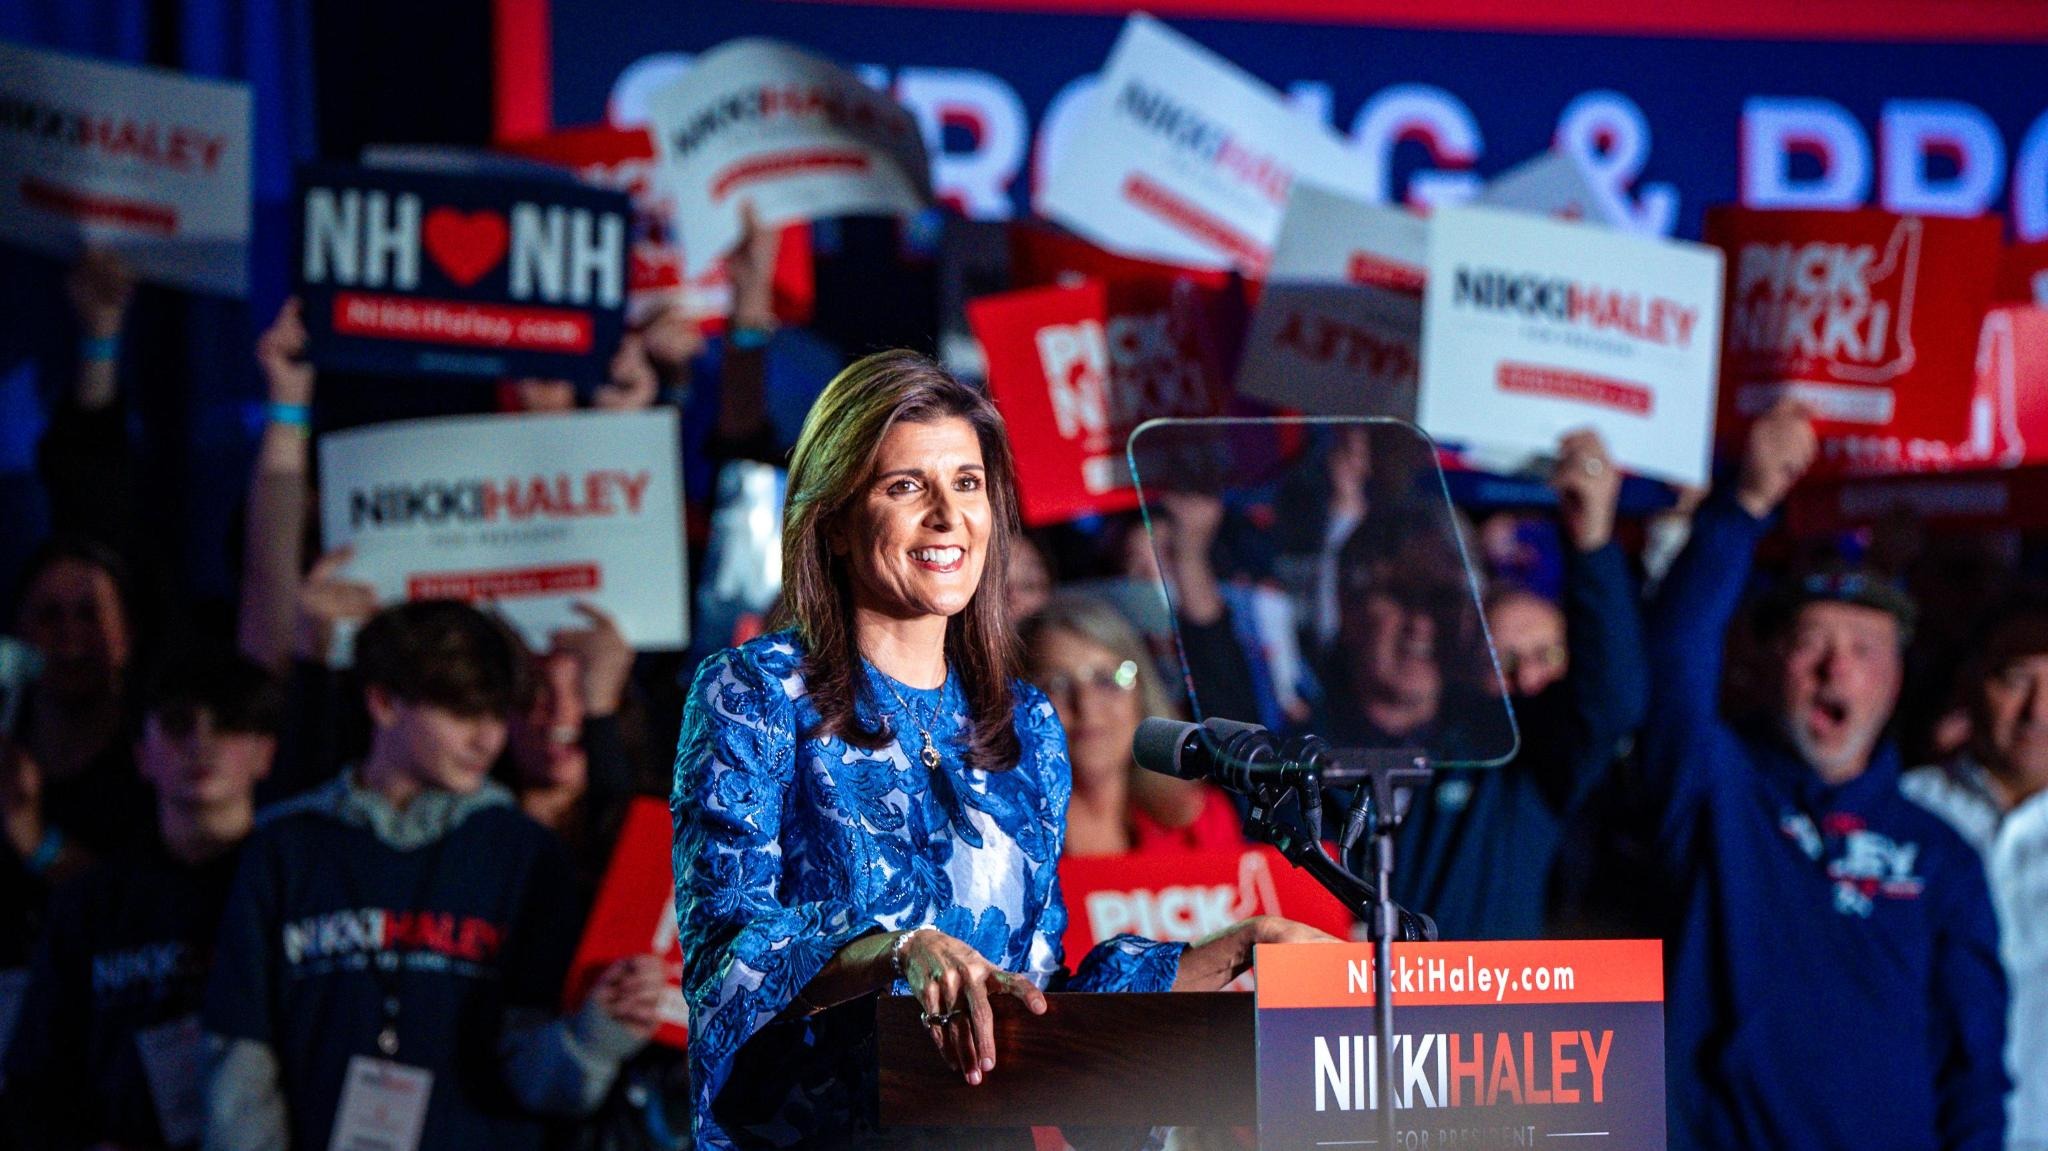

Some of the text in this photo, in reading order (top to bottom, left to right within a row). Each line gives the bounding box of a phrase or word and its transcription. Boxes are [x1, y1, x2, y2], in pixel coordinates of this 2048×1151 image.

[303, 186, 423, 292] NH
[507, 200, 625, 310] NH
[1737, 241, 1877, 298] PICK
[1453, 262, 1698, 348] NIKKIHALEY
[350, 468, 653, 530] NIKKIHALEY
[1085, 883, 1240, 948] PICK
